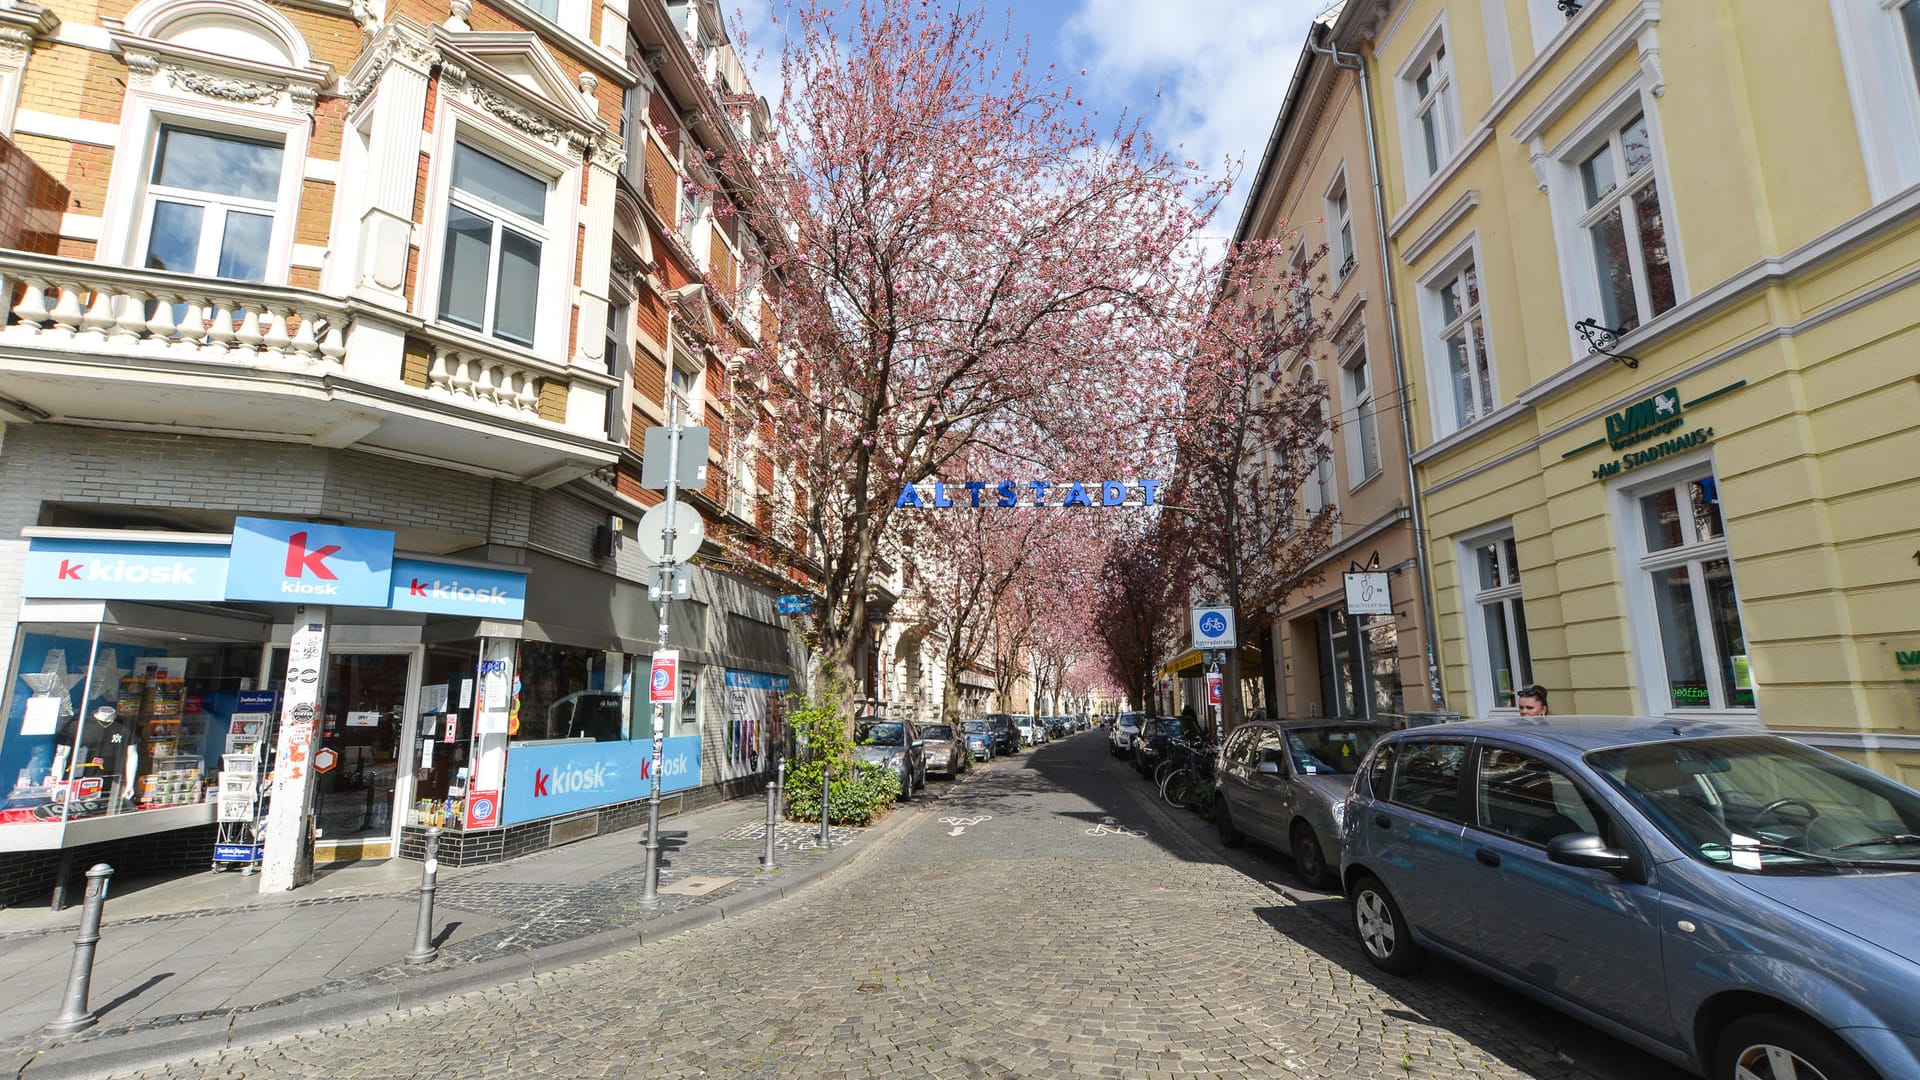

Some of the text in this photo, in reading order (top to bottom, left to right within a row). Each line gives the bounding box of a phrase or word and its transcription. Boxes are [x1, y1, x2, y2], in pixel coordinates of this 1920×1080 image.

[1605, 398, 1657, 443] LVM
[896, 479, 1160, 508] ALTSTADT
[58, 559, 196, 584] k kiosk
[281, 580, 338, 595] kiosk
[410, 578, 507, 605] k kiosk
[534, 762, 605, 798] k kiosk
[640, 756, 650, 780] k
